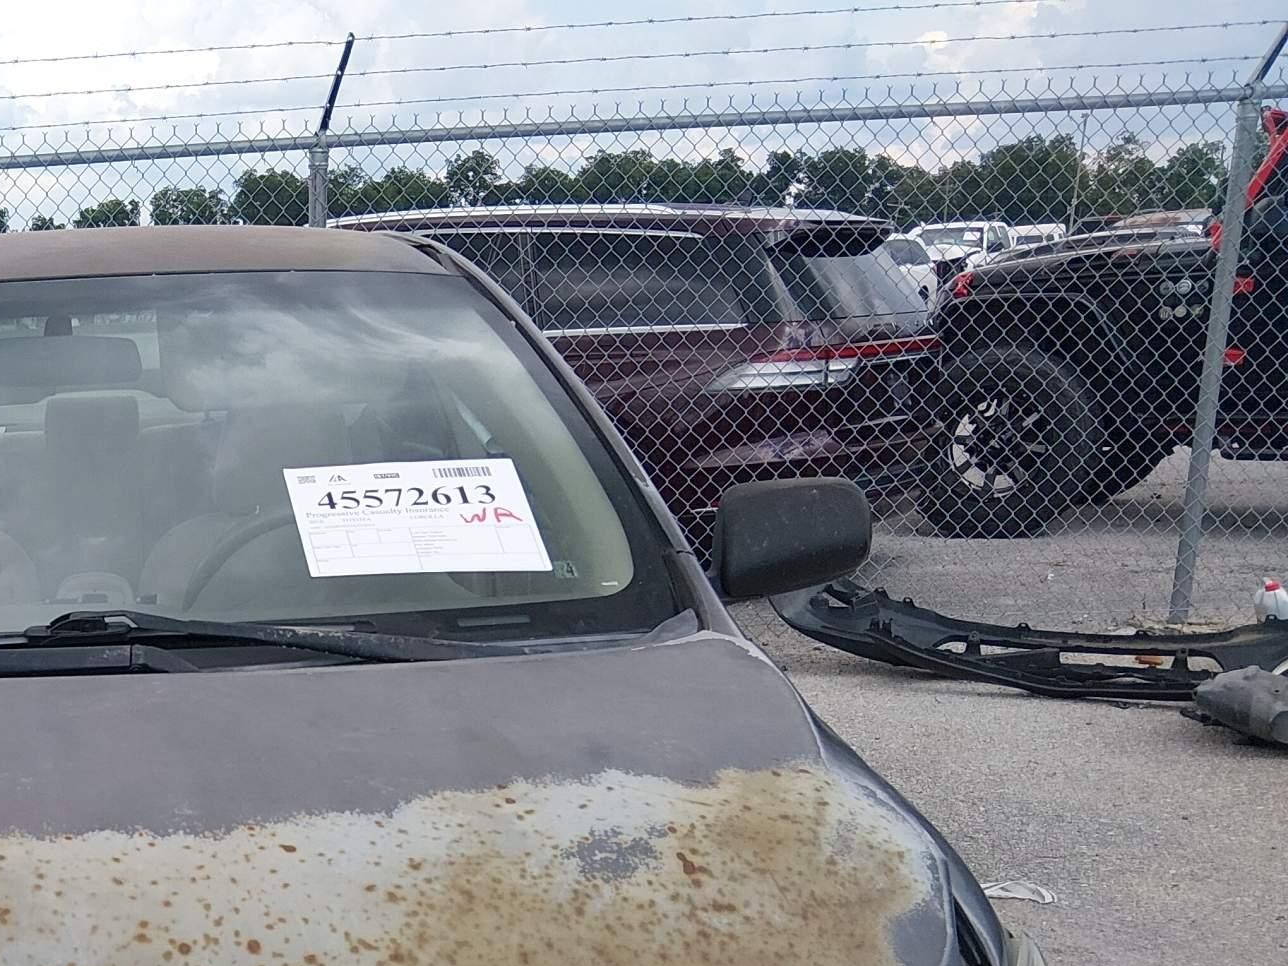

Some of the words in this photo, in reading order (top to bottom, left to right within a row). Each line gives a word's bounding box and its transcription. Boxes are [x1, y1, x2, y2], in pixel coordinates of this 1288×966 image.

[318, 485, 496, 509] 45572613
[305, 511, 360, 519] Progressive
[362, 508, 402, 516] Casualty
